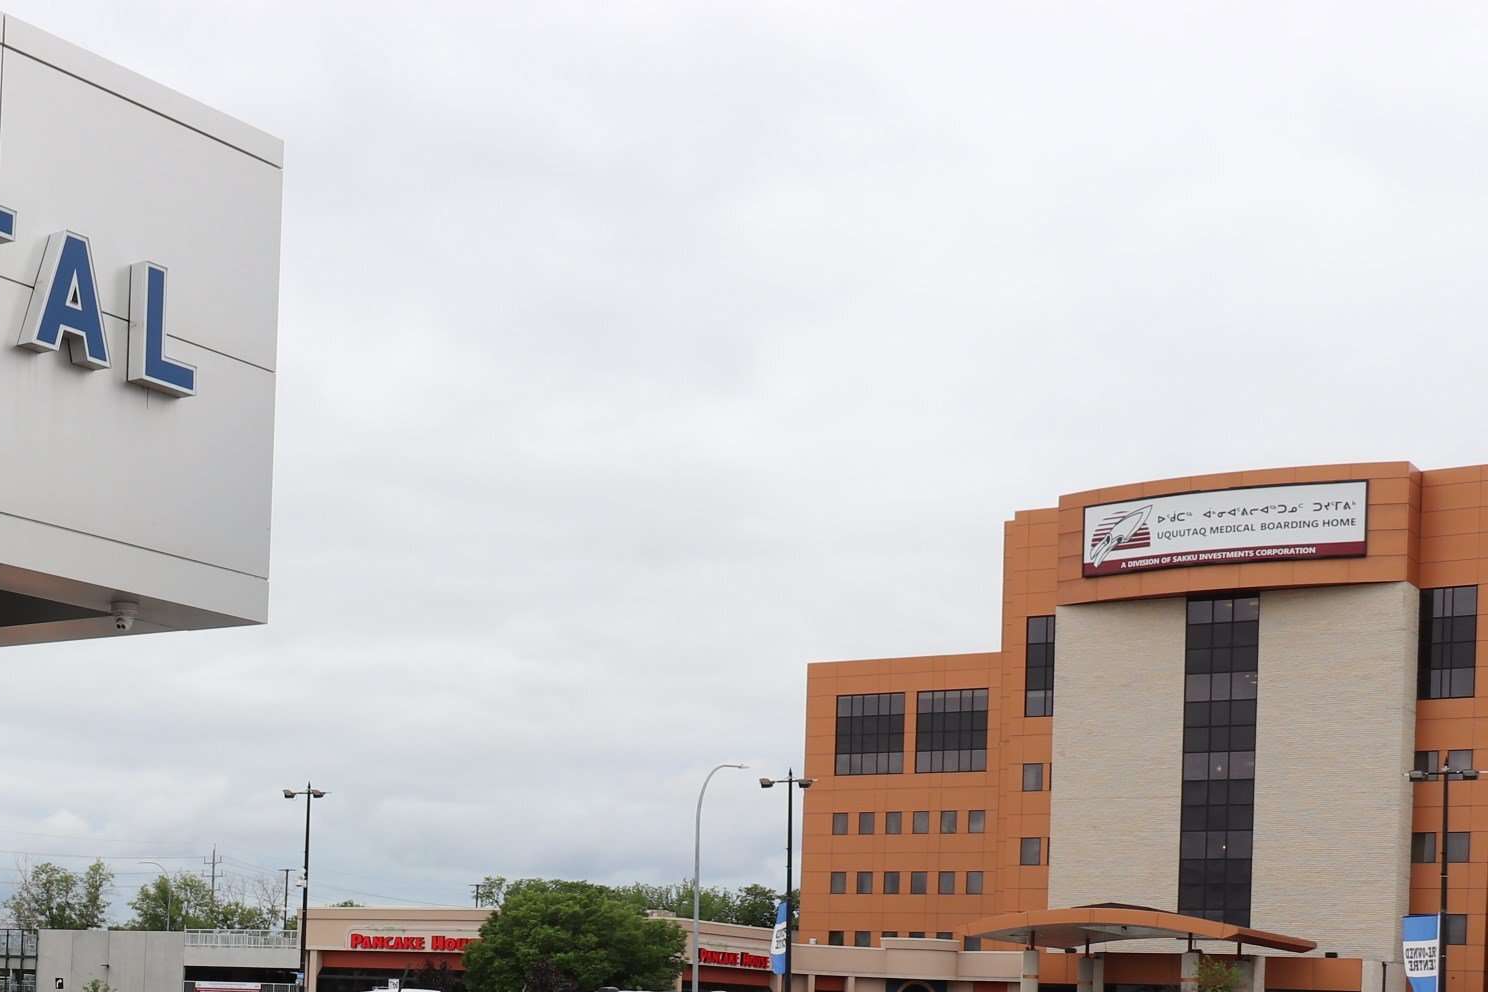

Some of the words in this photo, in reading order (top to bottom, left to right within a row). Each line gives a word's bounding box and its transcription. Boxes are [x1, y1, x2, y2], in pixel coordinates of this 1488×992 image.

[1157, 527, 1207, 540] UQUUTAQ
[1209, 523, 1256, 535] MEDICAL
[1260, 519, 1320, 532] BOARDING
[1322, 517, 1357, 528] HOME
[1120, 561, 1127, 569] A
[1127, 557, 1160, 568] DIVISION
[1161, 556, 1172, 564] OF
[1172, 553, 1198, 563] SAKKU
[1199, 549, 1254, 561] INVESTMENTS
[1255, 546, 1316, 557] CORPORATION
[350, 933, 426, 951] PANCAKE
[431, 936, 472, 951] HOU
[699, 947, 740, 966] PANCAKE
[741, 952, 771, 969] HOUSE
